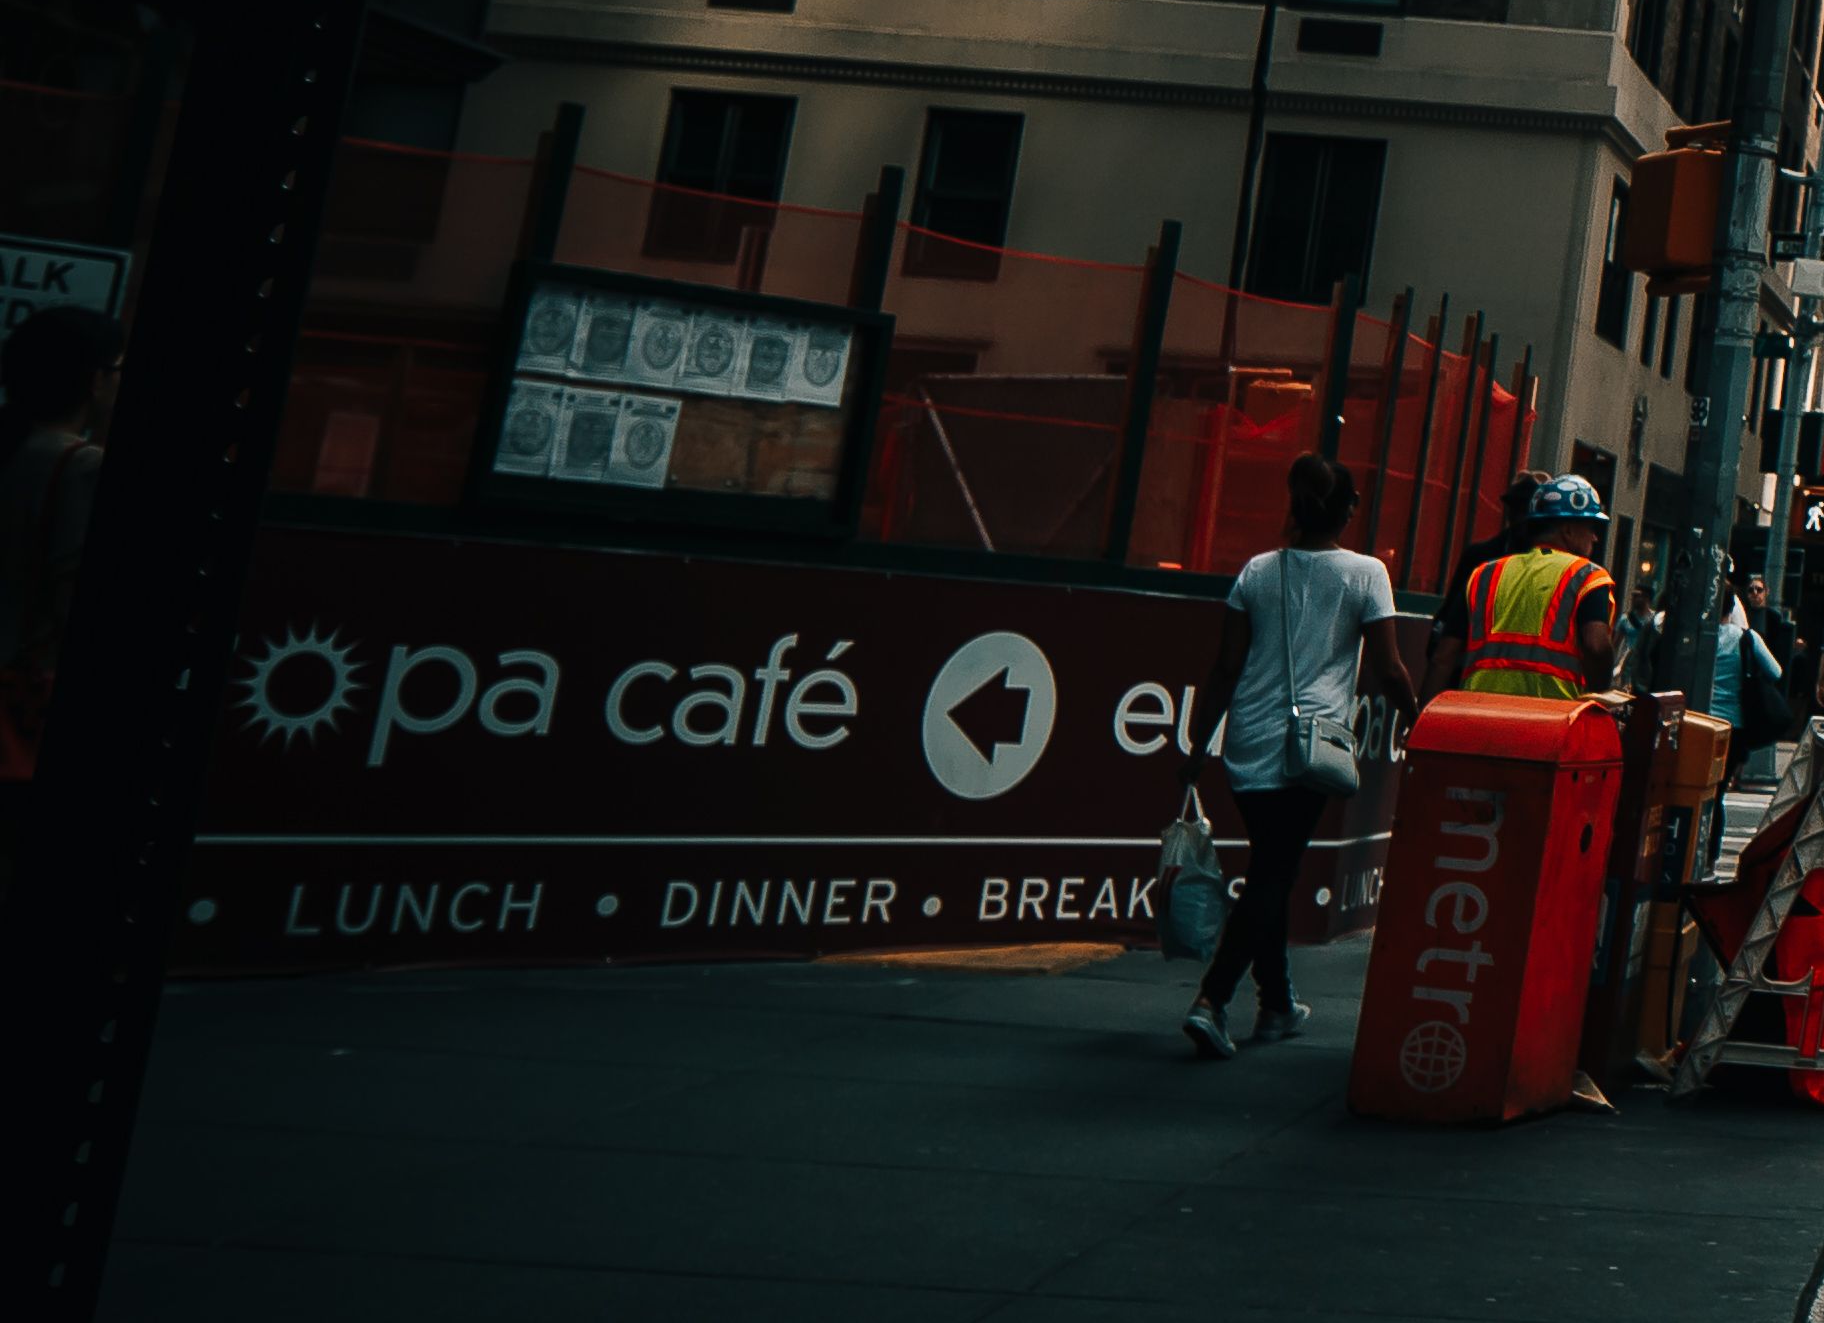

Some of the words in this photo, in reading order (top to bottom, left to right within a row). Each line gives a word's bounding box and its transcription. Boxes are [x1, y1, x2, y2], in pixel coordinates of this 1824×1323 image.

[603, 631, 859, 750] café
[284, 881, 545, 937] LUNCH
[659, 878, 899, 929] DINNER
